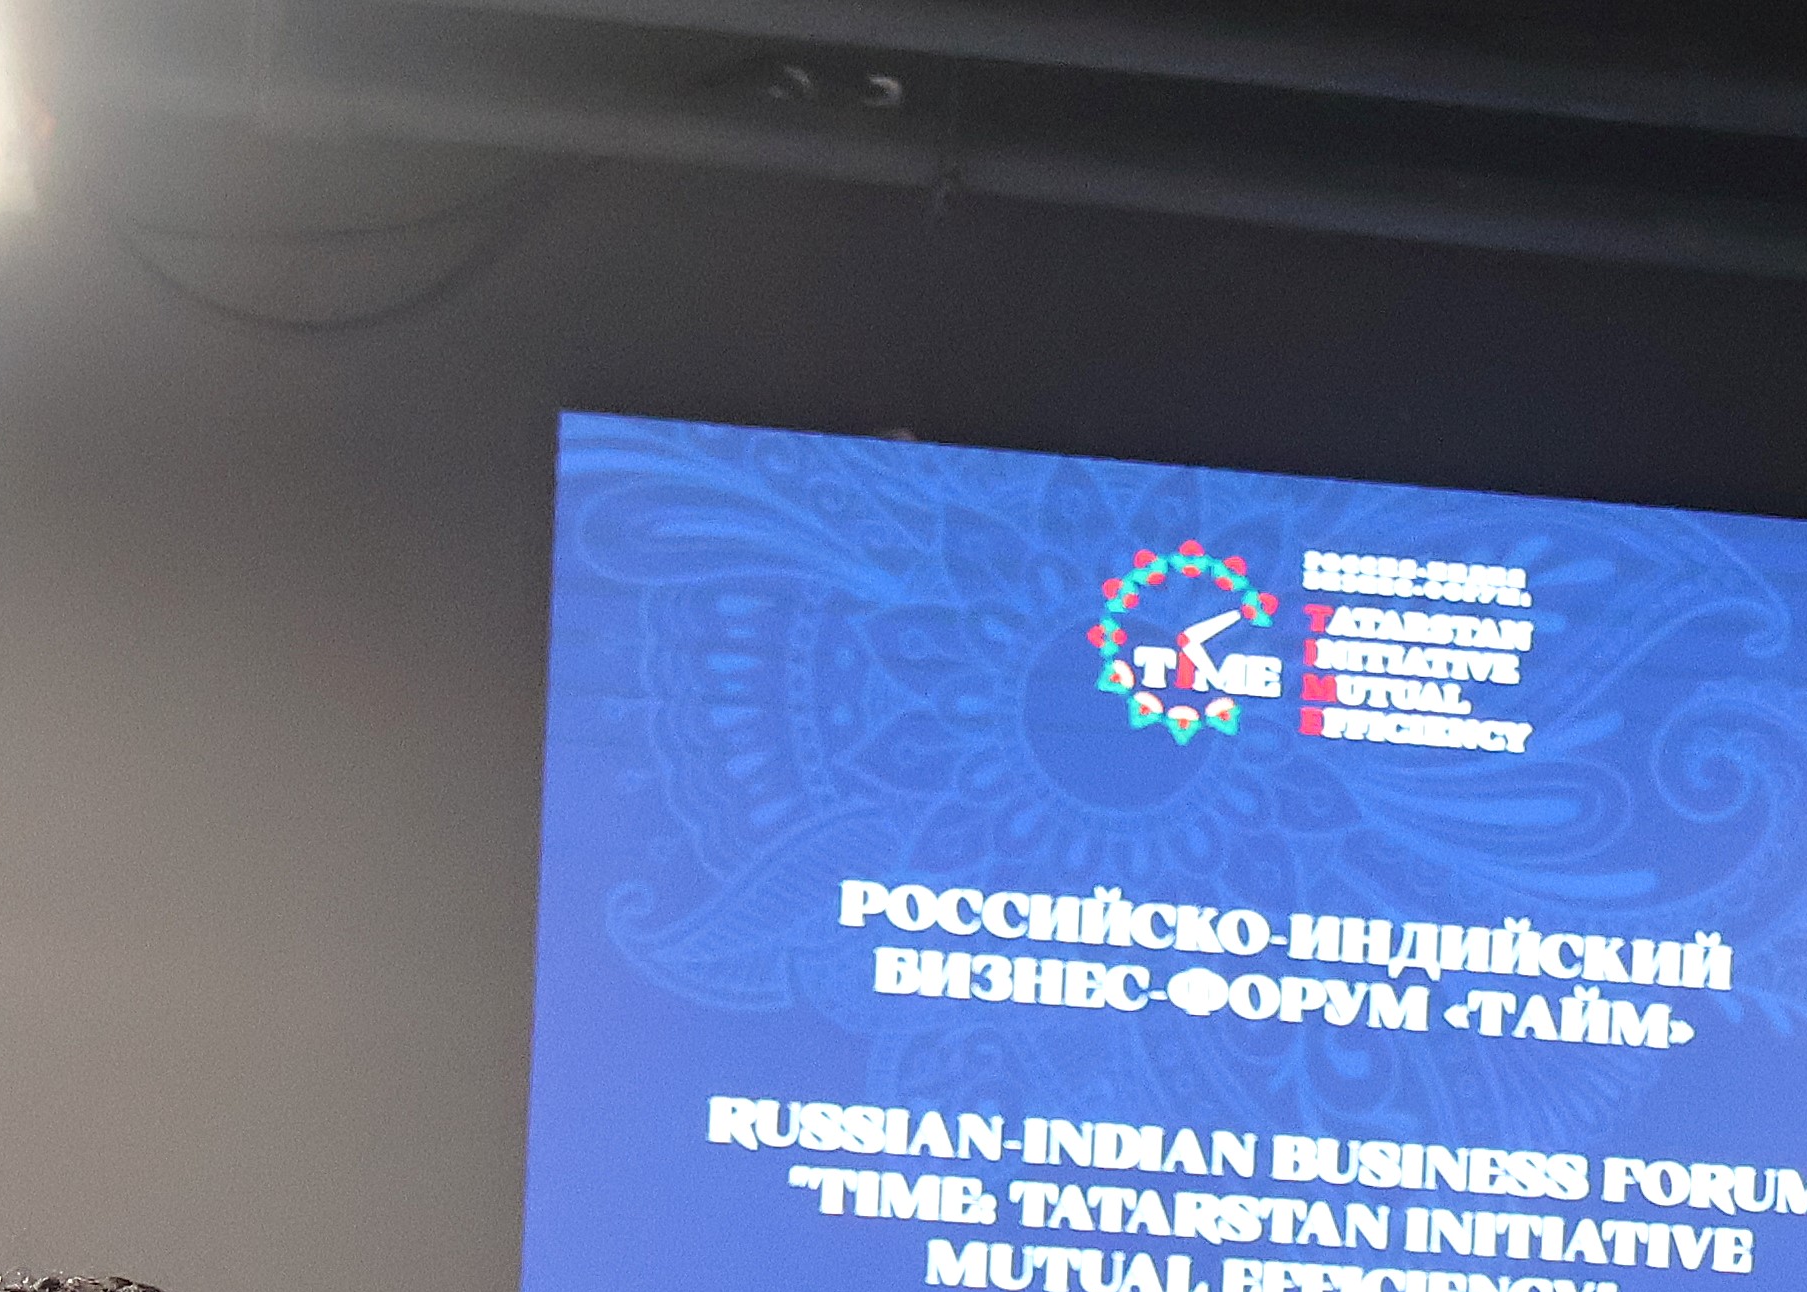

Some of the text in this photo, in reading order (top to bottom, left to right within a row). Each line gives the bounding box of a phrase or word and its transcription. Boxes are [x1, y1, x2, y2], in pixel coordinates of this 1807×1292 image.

[1303, 605, 1533, 651] TATARSTAN
[1133, 645, 1282, 698] TIME
[1303, 639, 1519, 684] INITIATIVE
[1301, 673, 1471, 714] MUTUAL
[1299, 706, 1532, 752] EFFICIENCY
[840, 880, 1731, 990] РОССИЙСКО-ИНДИЙСКИЙ
[875, 948, 1694, 1048] БИЗНЕС-ФОРУМ «ТАЙМ»
[709, 1097, 1256, 1177] RUSSIAN-INDIAN
[1273, 1136, 1589, 1199] BUSINESS
[1010, 1182, 1389, 1249] TATARSTAN
[1406, 1208, 1752, 1272] INITIATIVE
